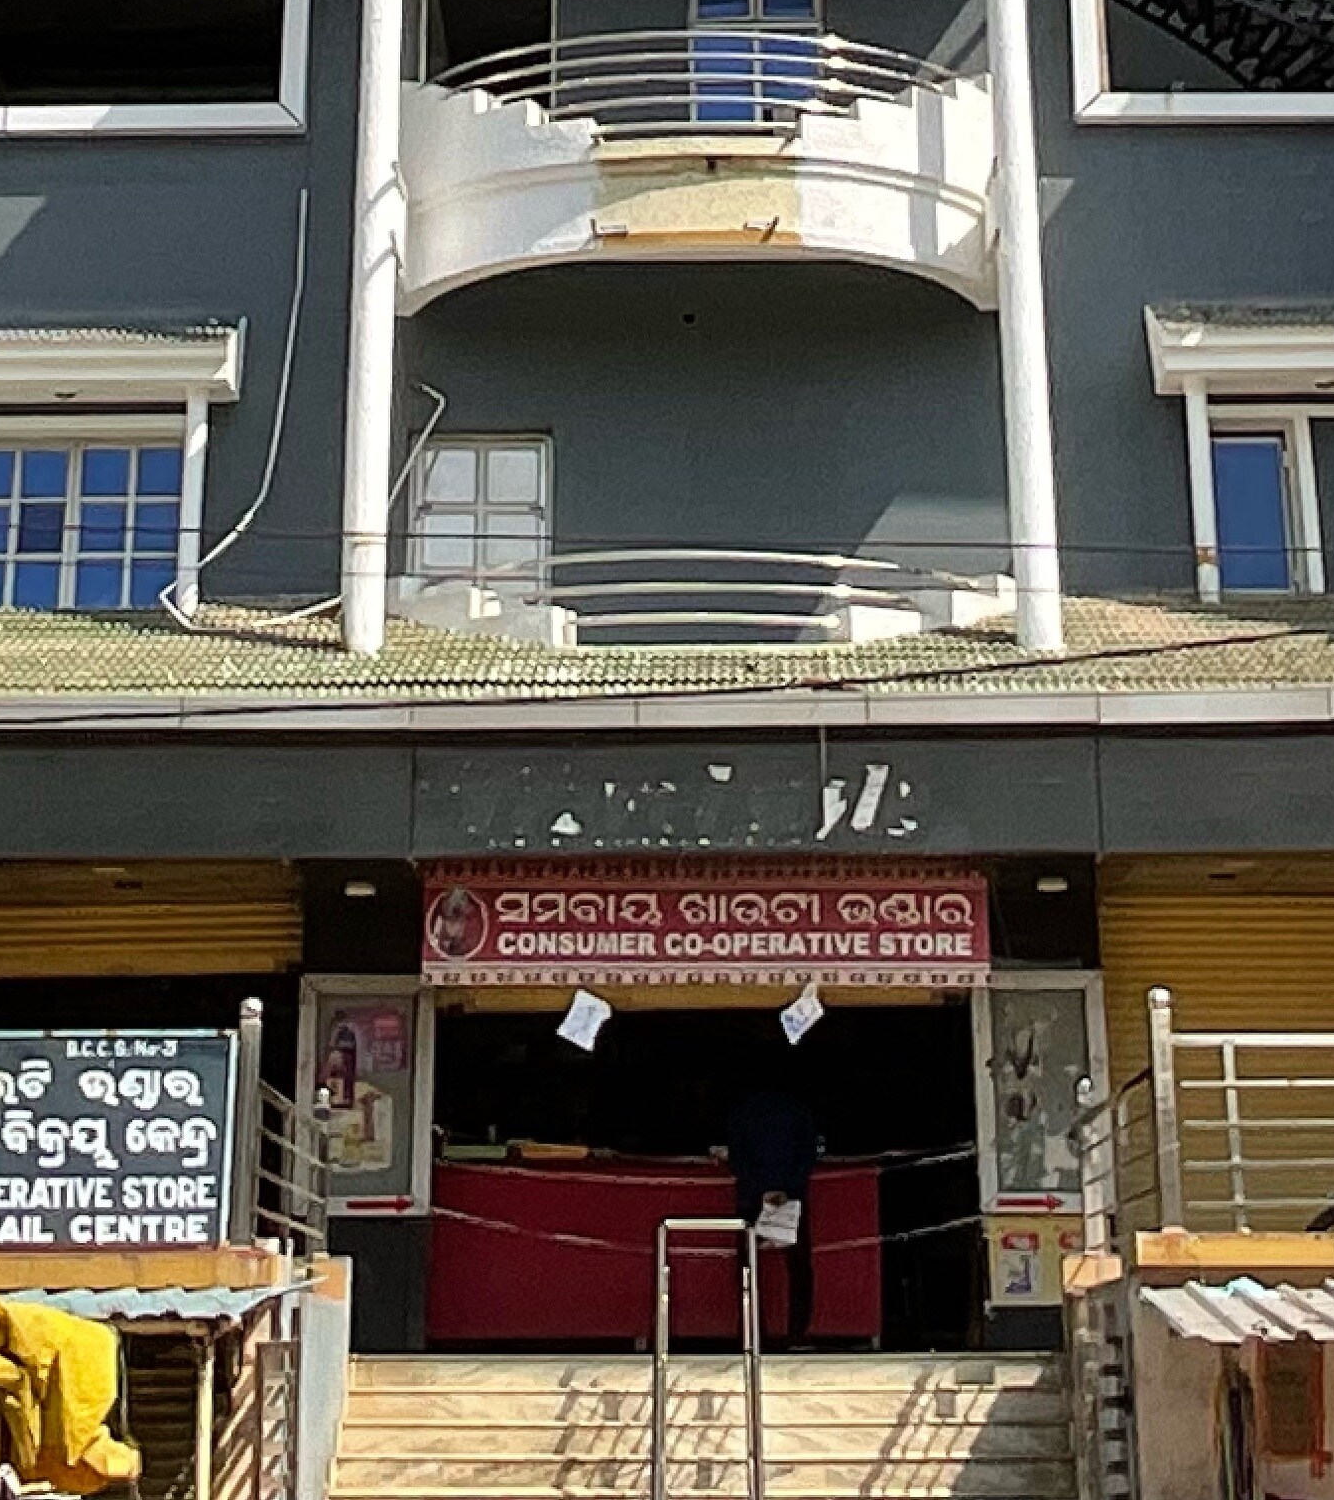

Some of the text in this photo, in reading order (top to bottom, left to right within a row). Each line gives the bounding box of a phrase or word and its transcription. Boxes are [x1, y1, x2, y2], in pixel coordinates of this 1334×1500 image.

[495, 892, 663, 925] ସମବାୟ
[497, 931, 973, 956] CONSUMER CO-OPERATIVE STORE
[121, 1176, 218, 1209] STORE
[69, 1216, 209, 1243] CENTRE
